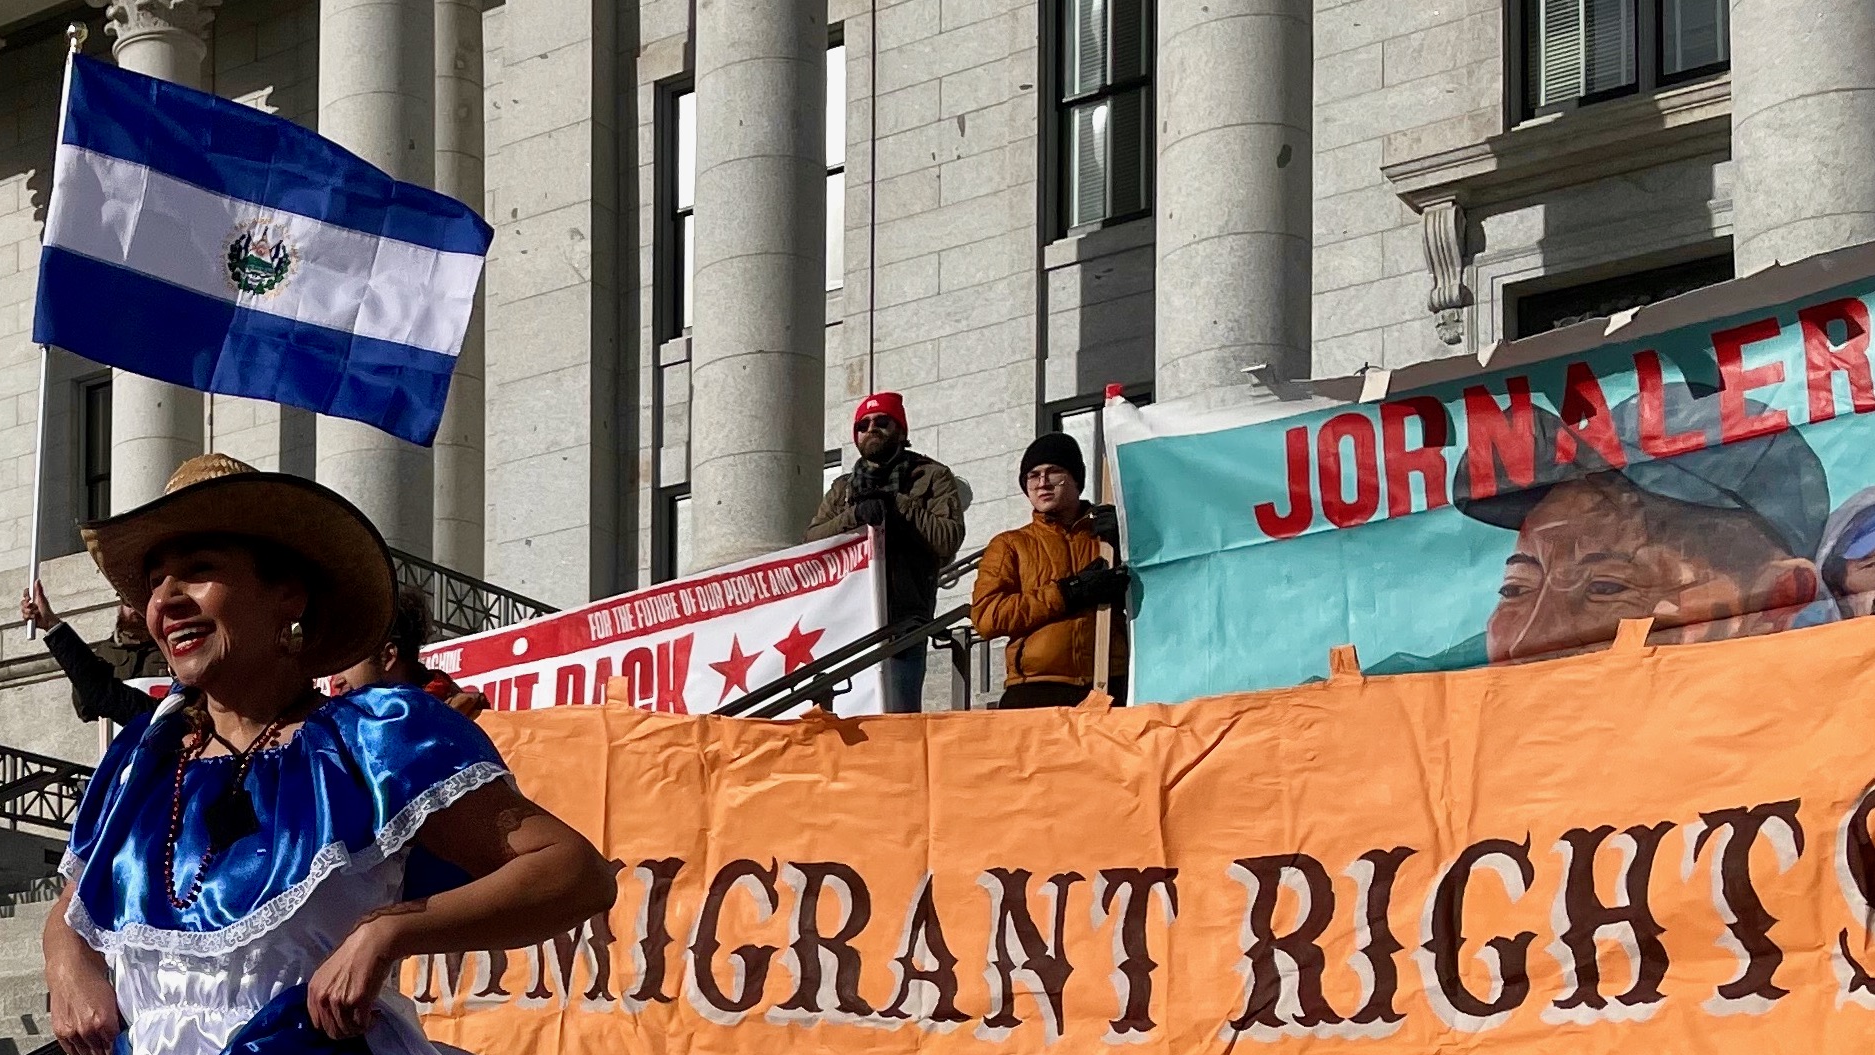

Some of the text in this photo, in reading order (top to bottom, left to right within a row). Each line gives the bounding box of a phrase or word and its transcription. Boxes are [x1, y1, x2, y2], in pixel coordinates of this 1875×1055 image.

[1254, 297, 1875, 540] JORNALER
[587, 540, 873, 641] FOR THE FUTURE OF OUR PEOPLE AND OUR PLANET
